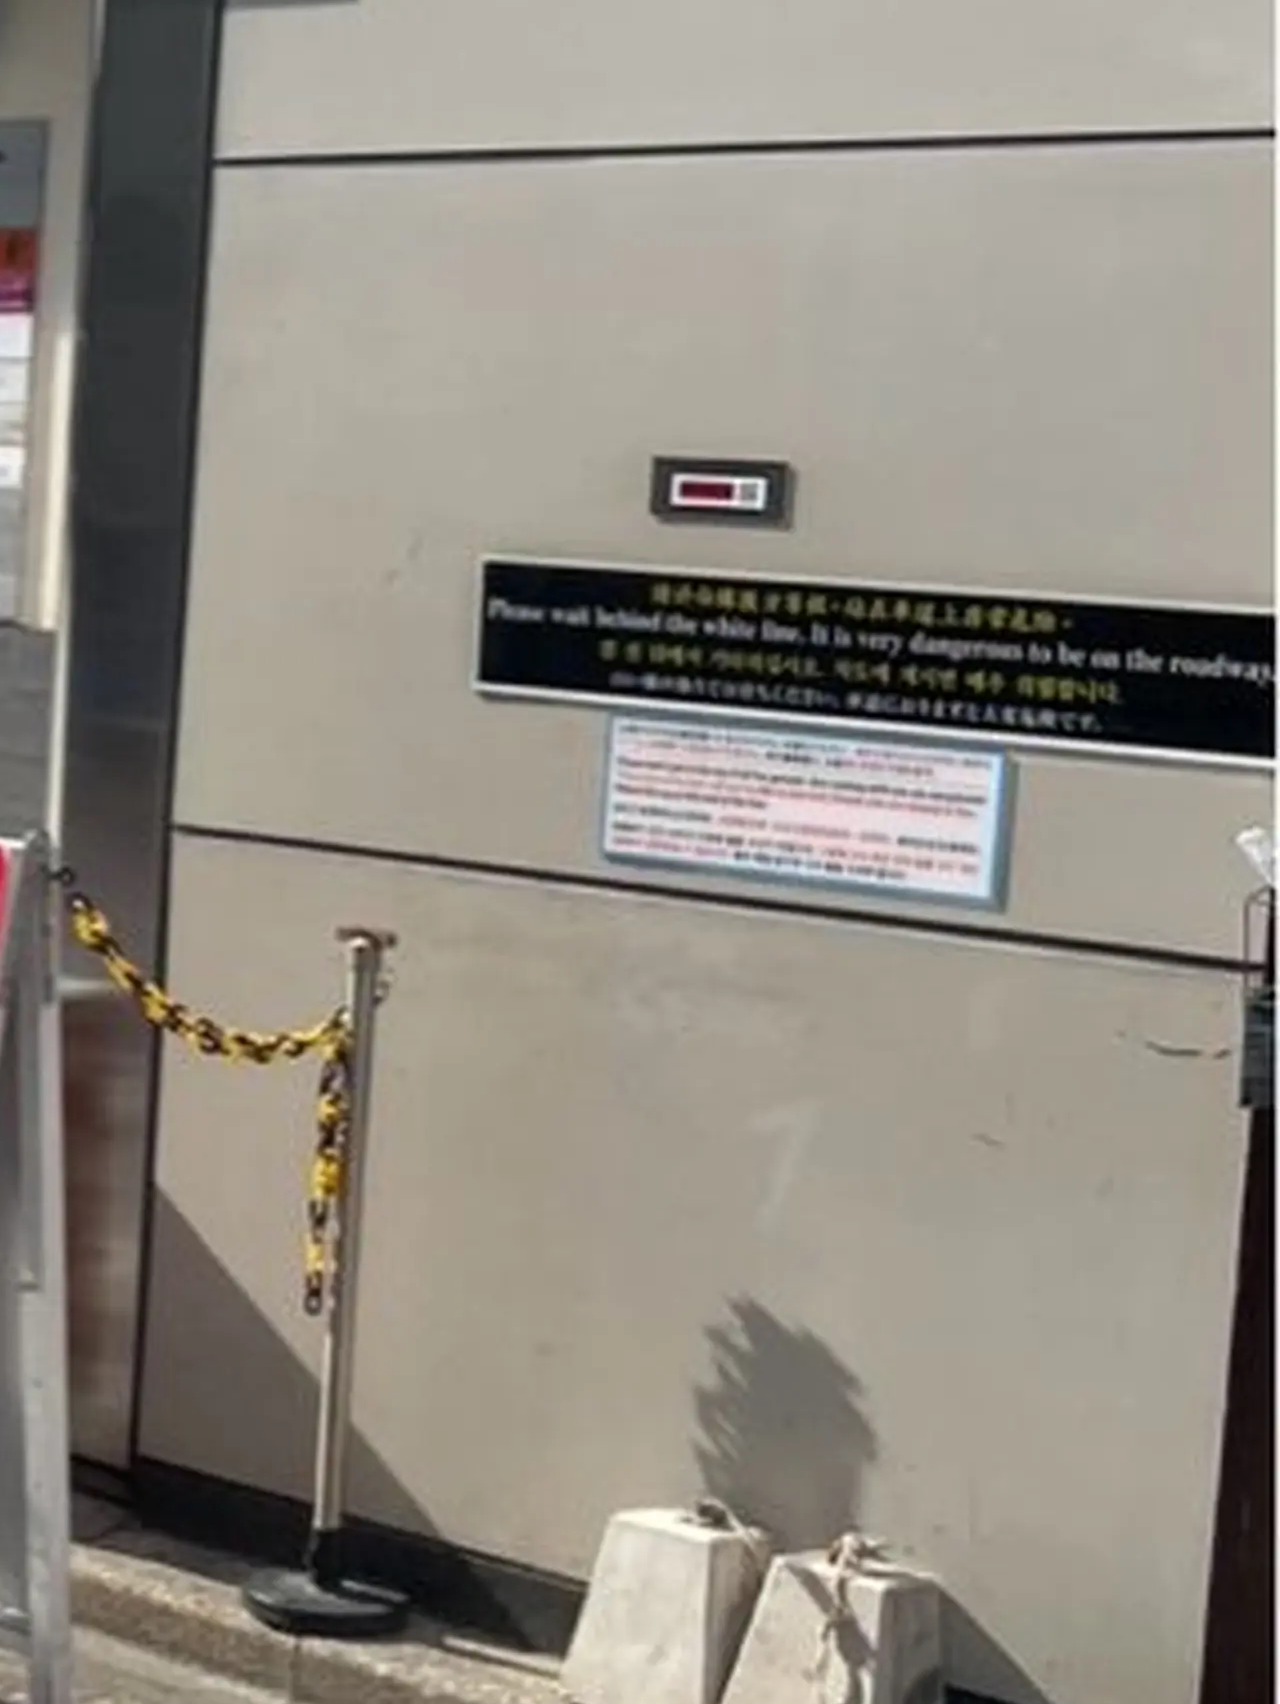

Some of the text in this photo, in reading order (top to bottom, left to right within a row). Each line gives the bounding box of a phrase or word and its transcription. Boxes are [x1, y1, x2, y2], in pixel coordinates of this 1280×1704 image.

[702, 615, 754, 641] white
[832, 625, 851, 647] is
[858, 630, 902, 658] very
[908, 629, 1022, 666] dangerous
[1028, 640, 1051, 665] to
[1058, 641, 1085, 667] be
[1091, 650, 1119, 670] on
[1125, 646, 1161, 674] the
